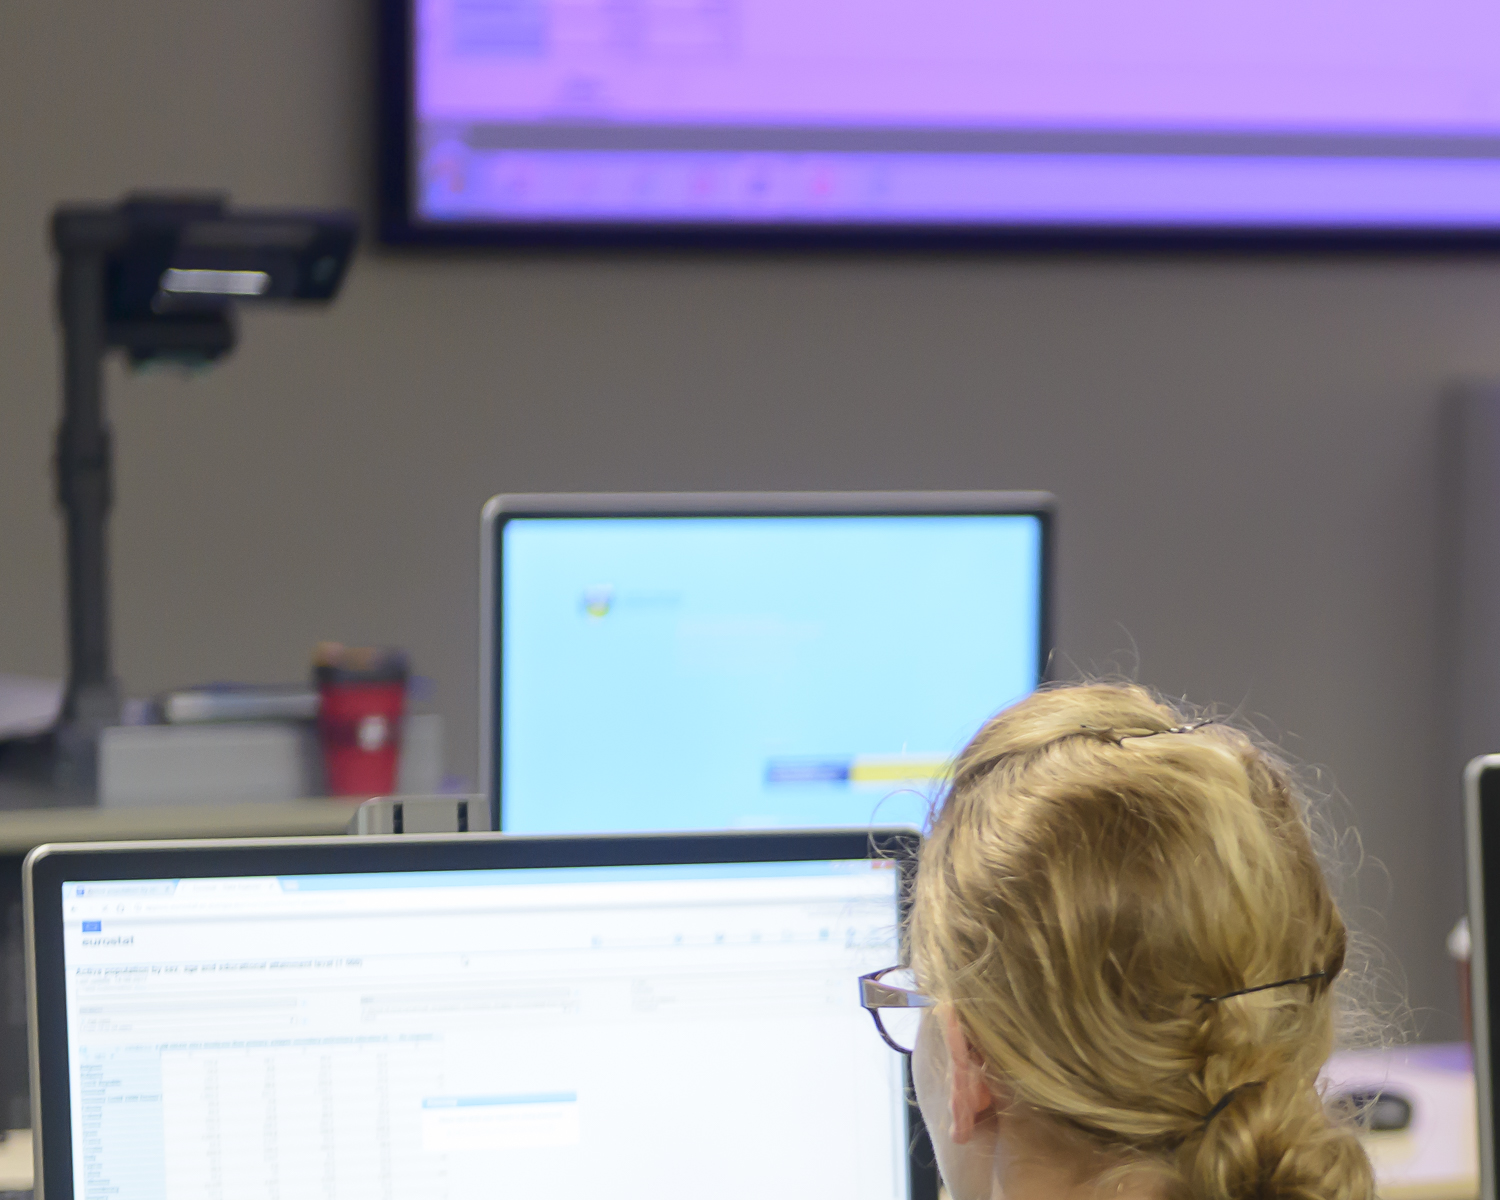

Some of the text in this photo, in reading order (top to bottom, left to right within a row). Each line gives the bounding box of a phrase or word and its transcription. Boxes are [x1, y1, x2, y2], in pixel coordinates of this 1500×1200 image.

[81, 935, 134, 947] eurostat
[104, 964, 150, 977] population
[151, 964, 162, 976] by
[201, 961, 217, 972] and
[218, 960, 267, 972] educational
